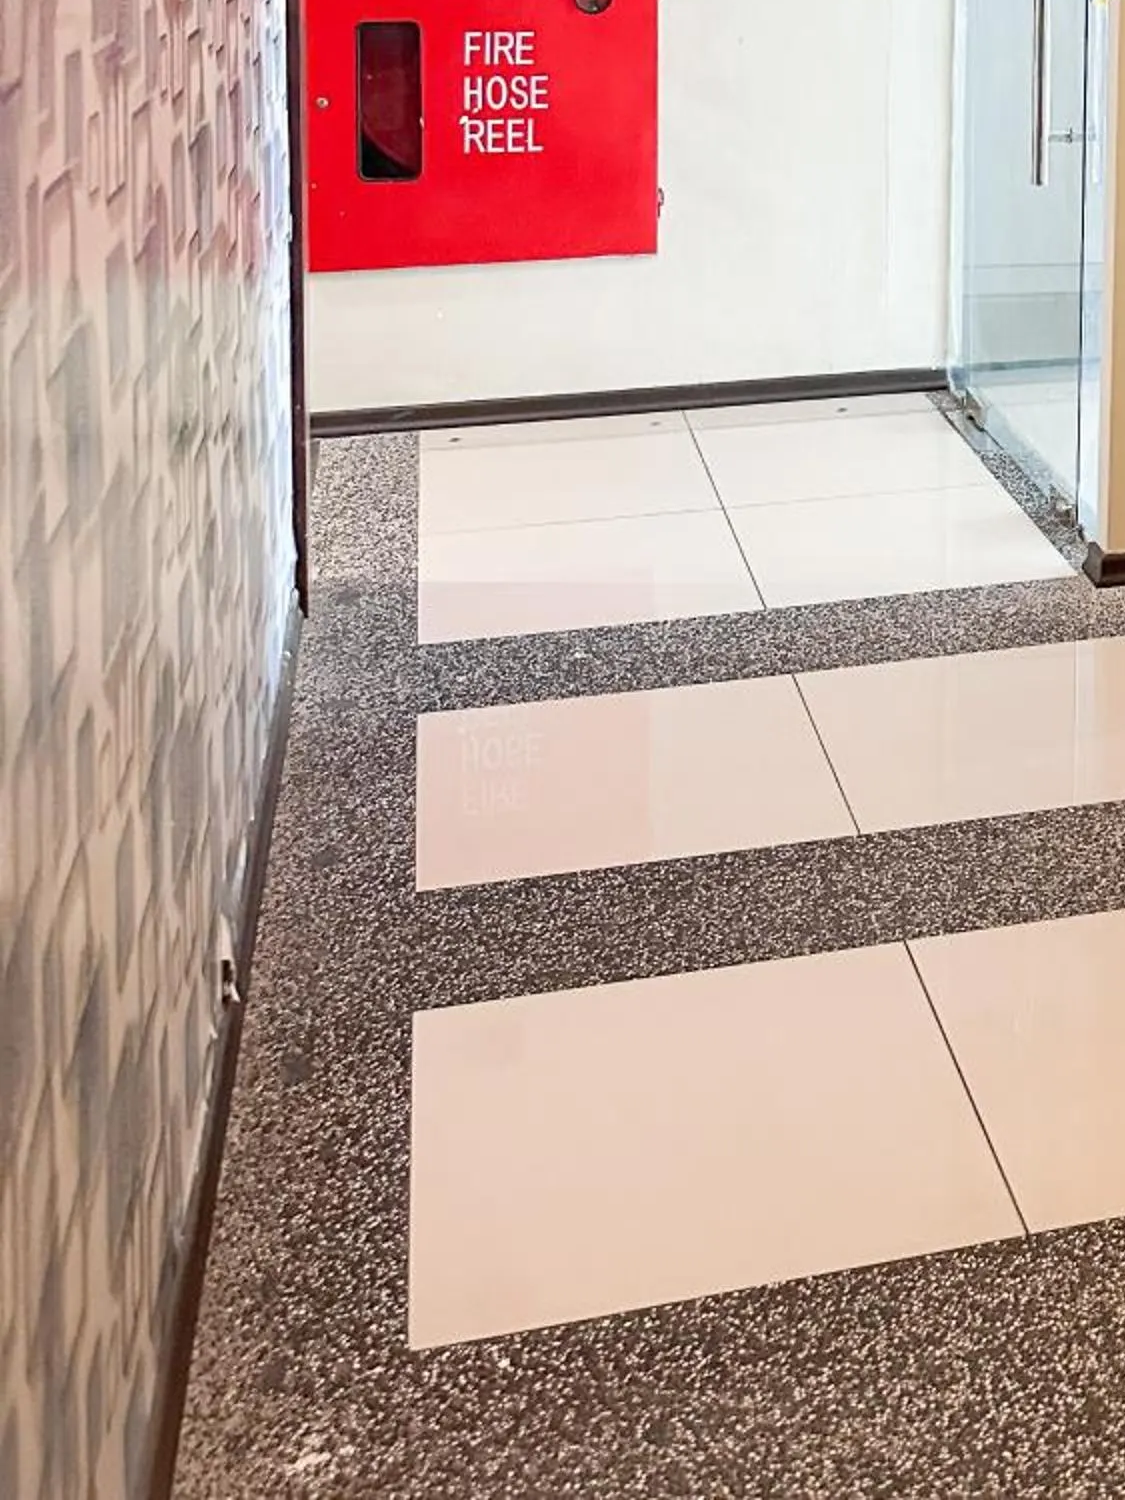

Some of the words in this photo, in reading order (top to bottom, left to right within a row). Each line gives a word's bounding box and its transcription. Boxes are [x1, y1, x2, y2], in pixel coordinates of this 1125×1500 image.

[463, 31, 535, 66] FIRE
[463, 75, 549, 111] HOSE
[463, 117, 544, 154] REEL
